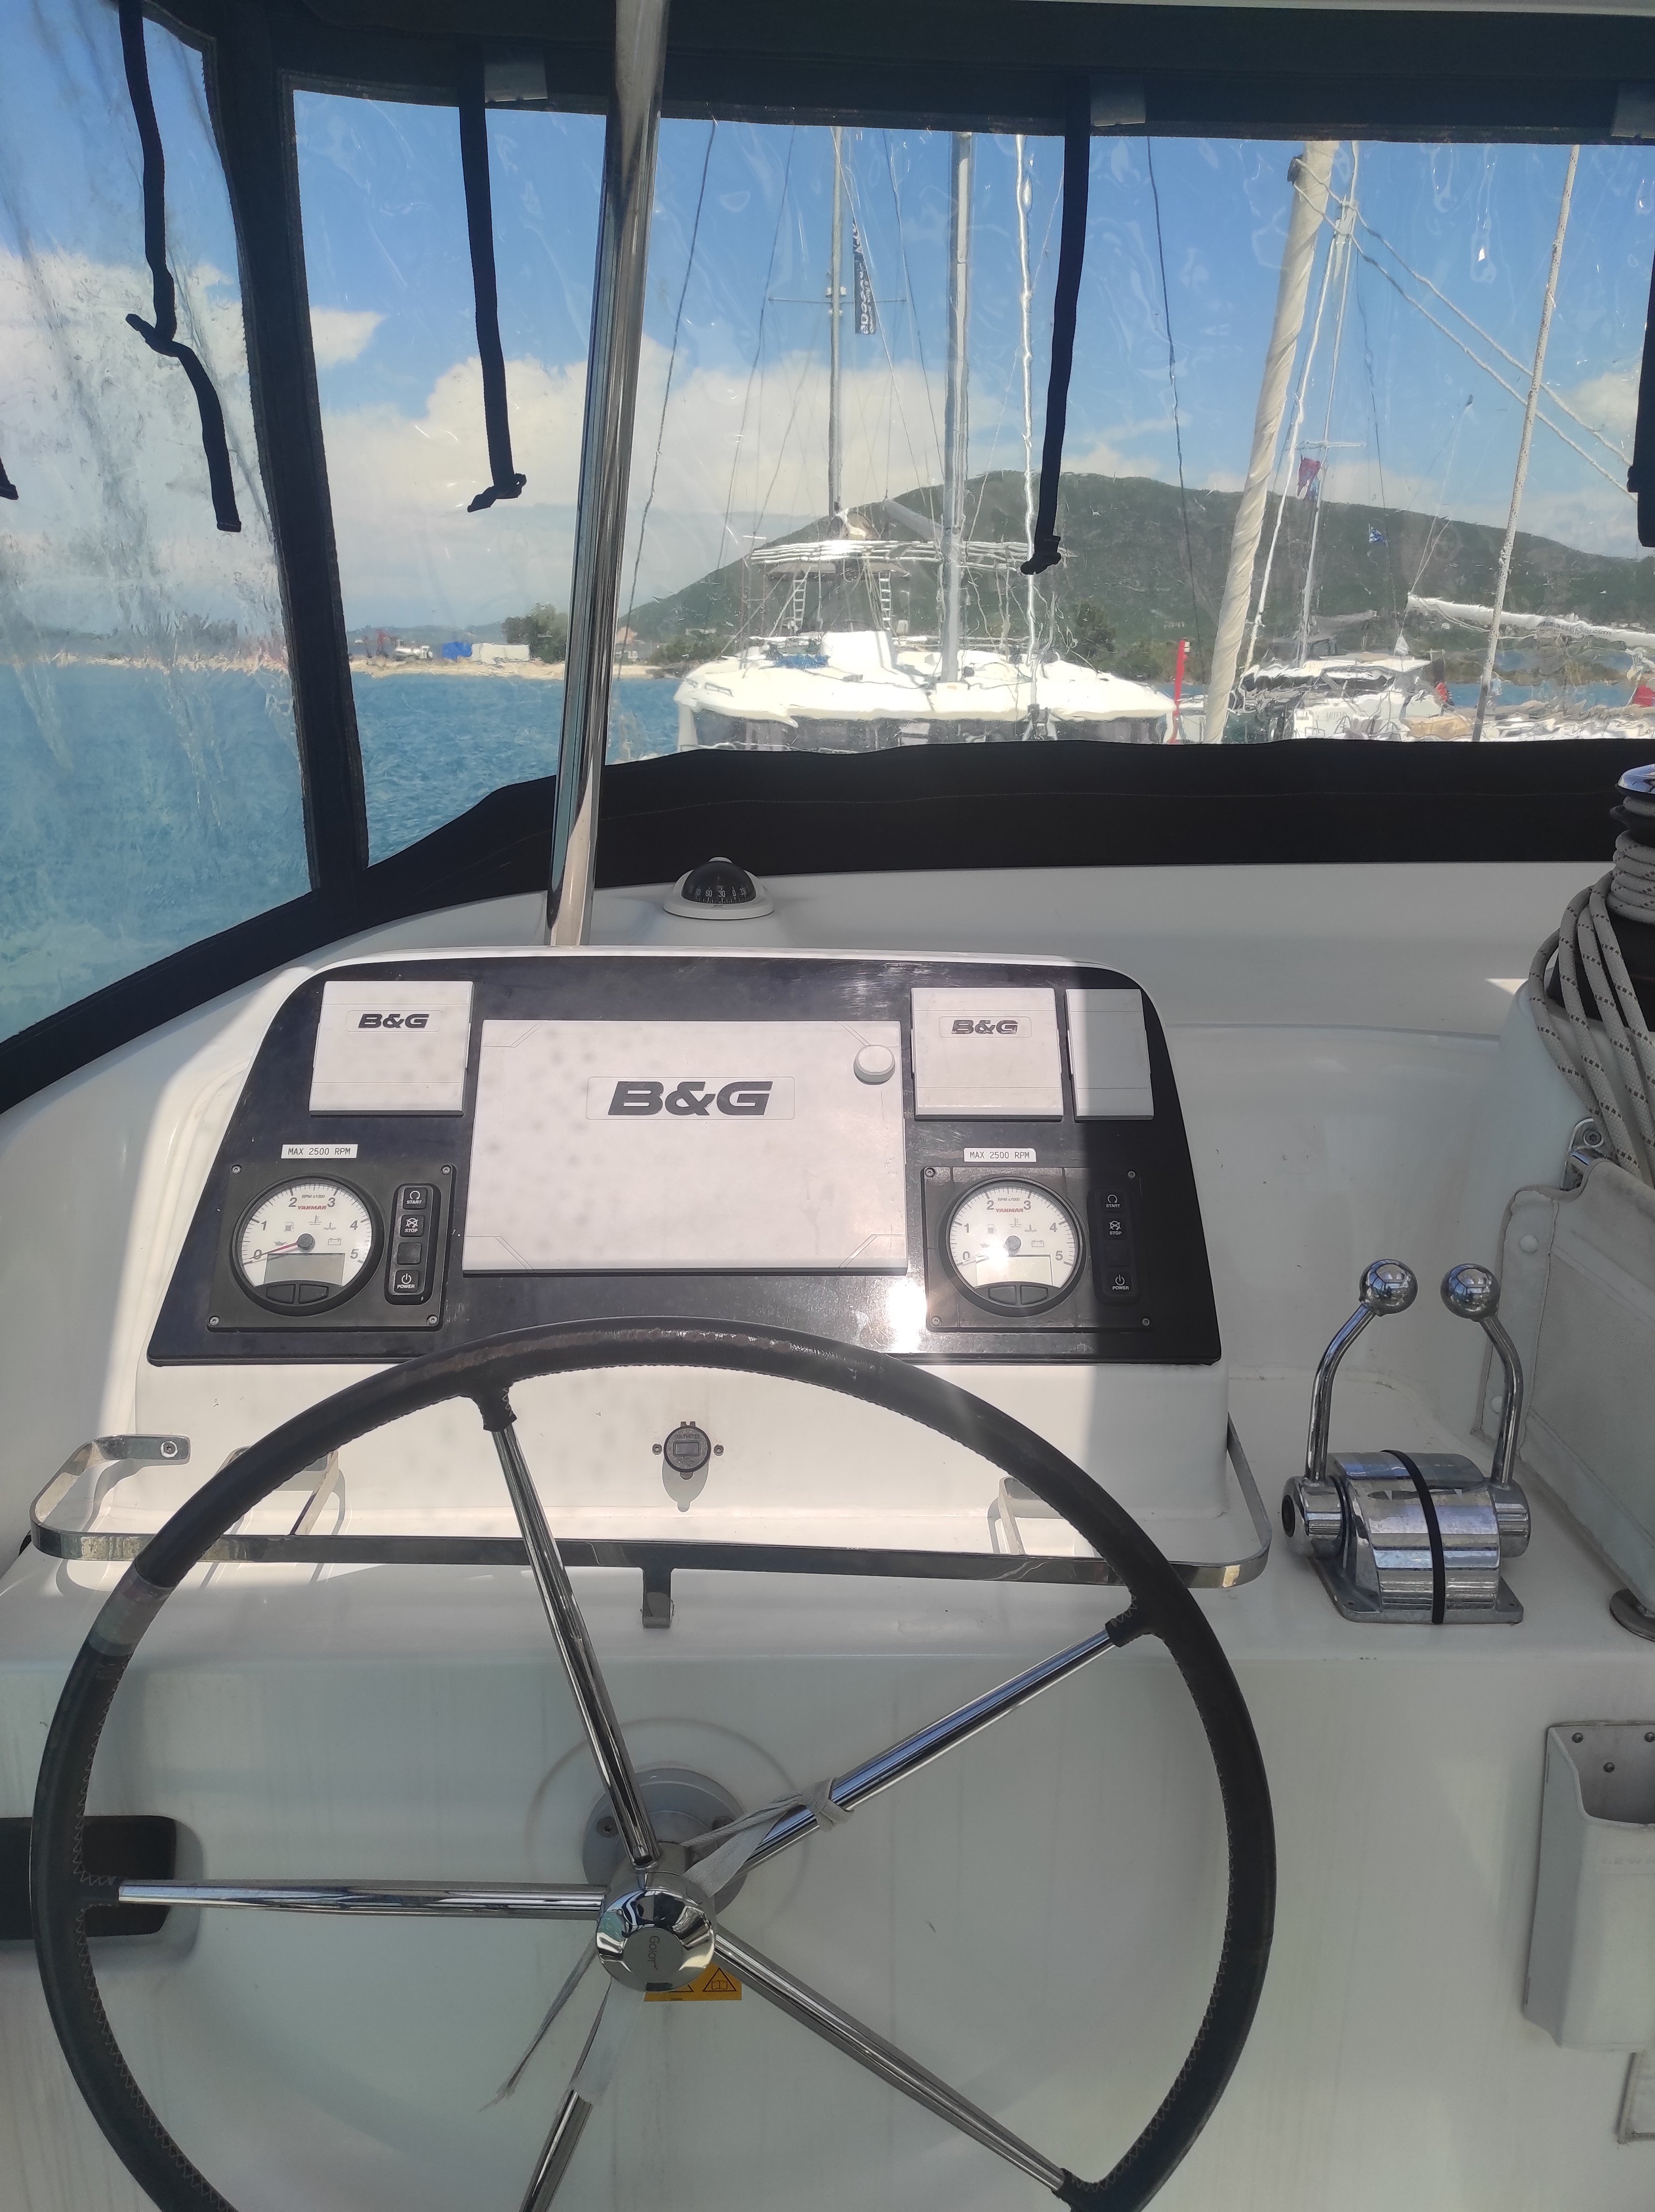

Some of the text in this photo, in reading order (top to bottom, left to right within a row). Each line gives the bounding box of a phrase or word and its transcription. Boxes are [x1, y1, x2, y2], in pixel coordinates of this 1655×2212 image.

[358, 1014, 430, 1029] B&G
[951, 1019, 1018, 1034] B&G
[608, 1081, 773, 1116] B&G
[288, 1197, 297, 1208] 2
[327, 1197, 336, 1208] 3
[987, 1200, 994, 1210] 2
[1023, 1200, 1031, 1210] 3
[261, 1221, 268, 1230] 1
[349, 1220, 358, 1230] 4
[964, 1224, 970, 1233] 1
[1050, 1223, 1057, 1232] 4
[254, 1249, 262, 1260] 0
[350, 1249, 358, 1259] 5
[962, 1251, 971, 1261] 0
[1055, 1251, 1063, 1260] 5
